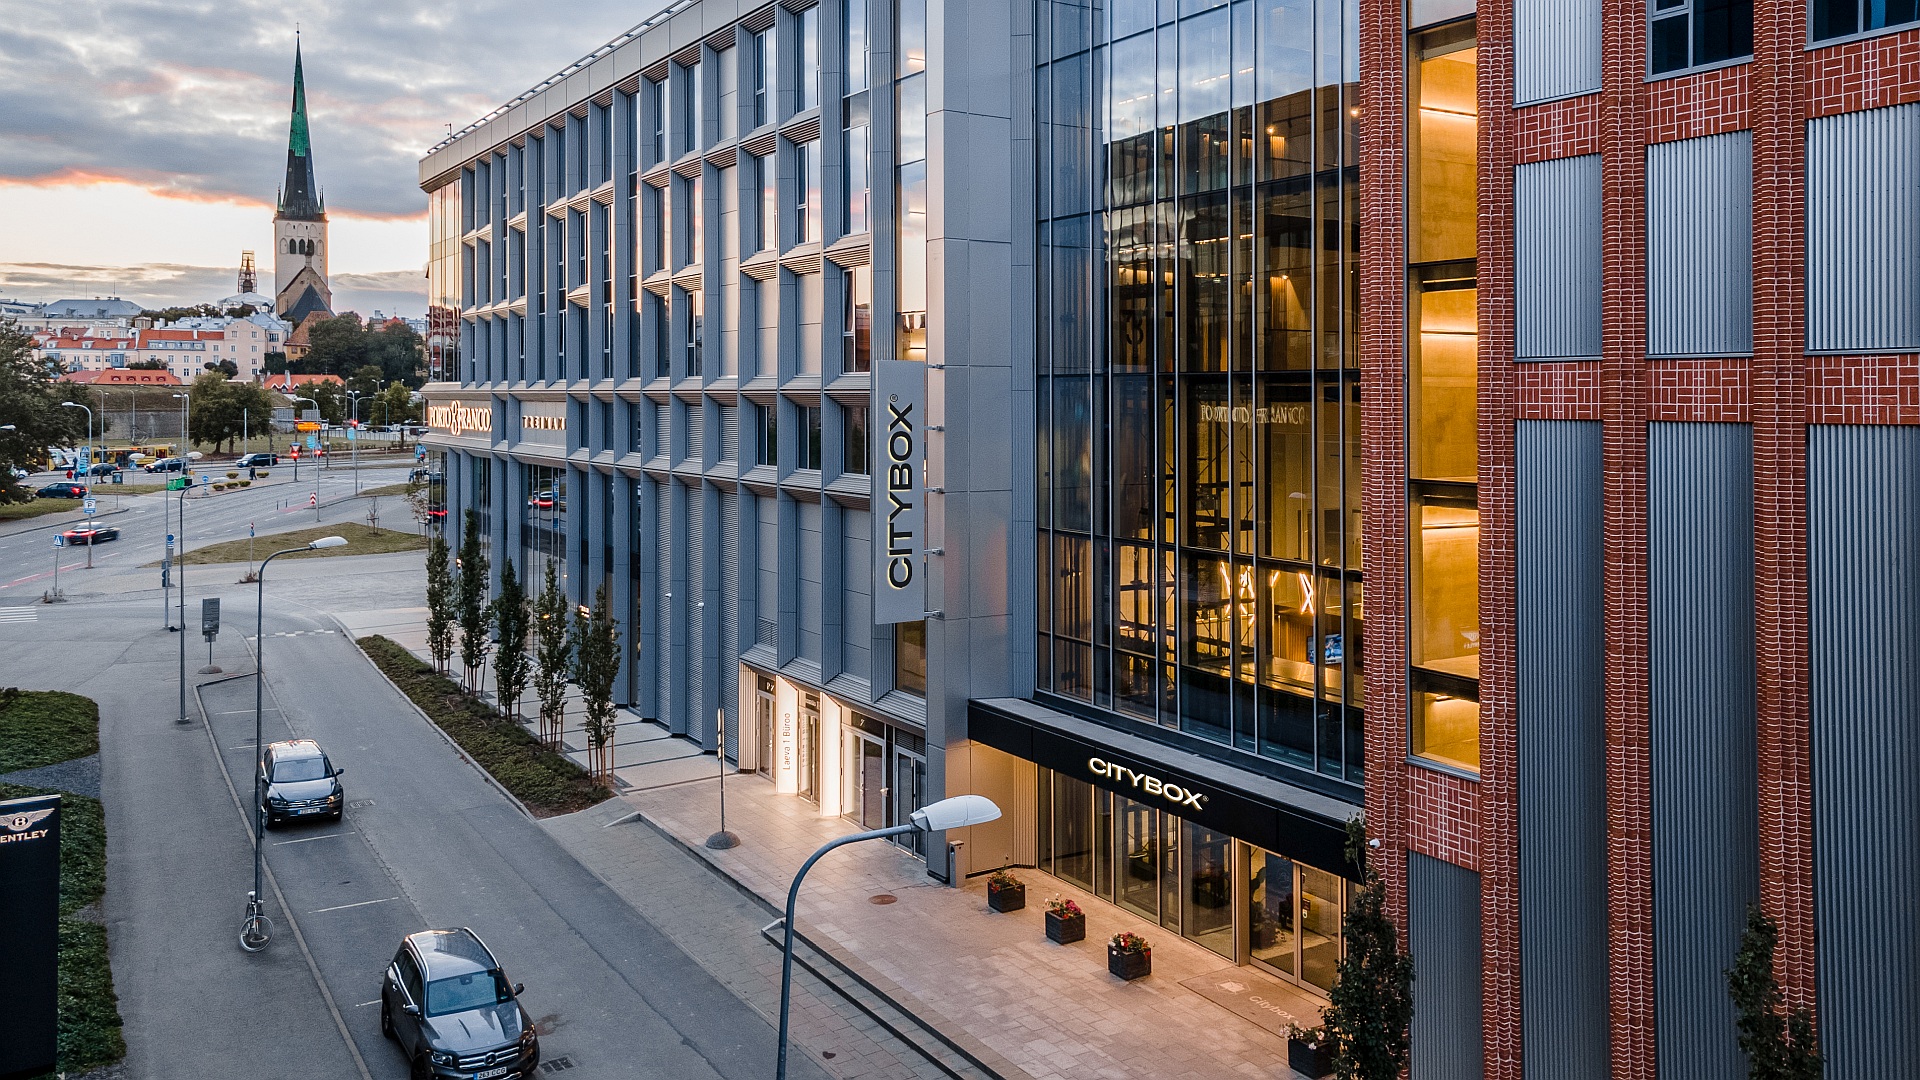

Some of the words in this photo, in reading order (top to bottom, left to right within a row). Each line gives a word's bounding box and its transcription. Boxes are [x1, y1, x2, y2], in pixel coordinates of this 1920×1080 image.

[782, 712, 791, 737] Büroo
[782, 745, 791, 770] Laeva
[0, 829, 48, 844] ENTLEY
